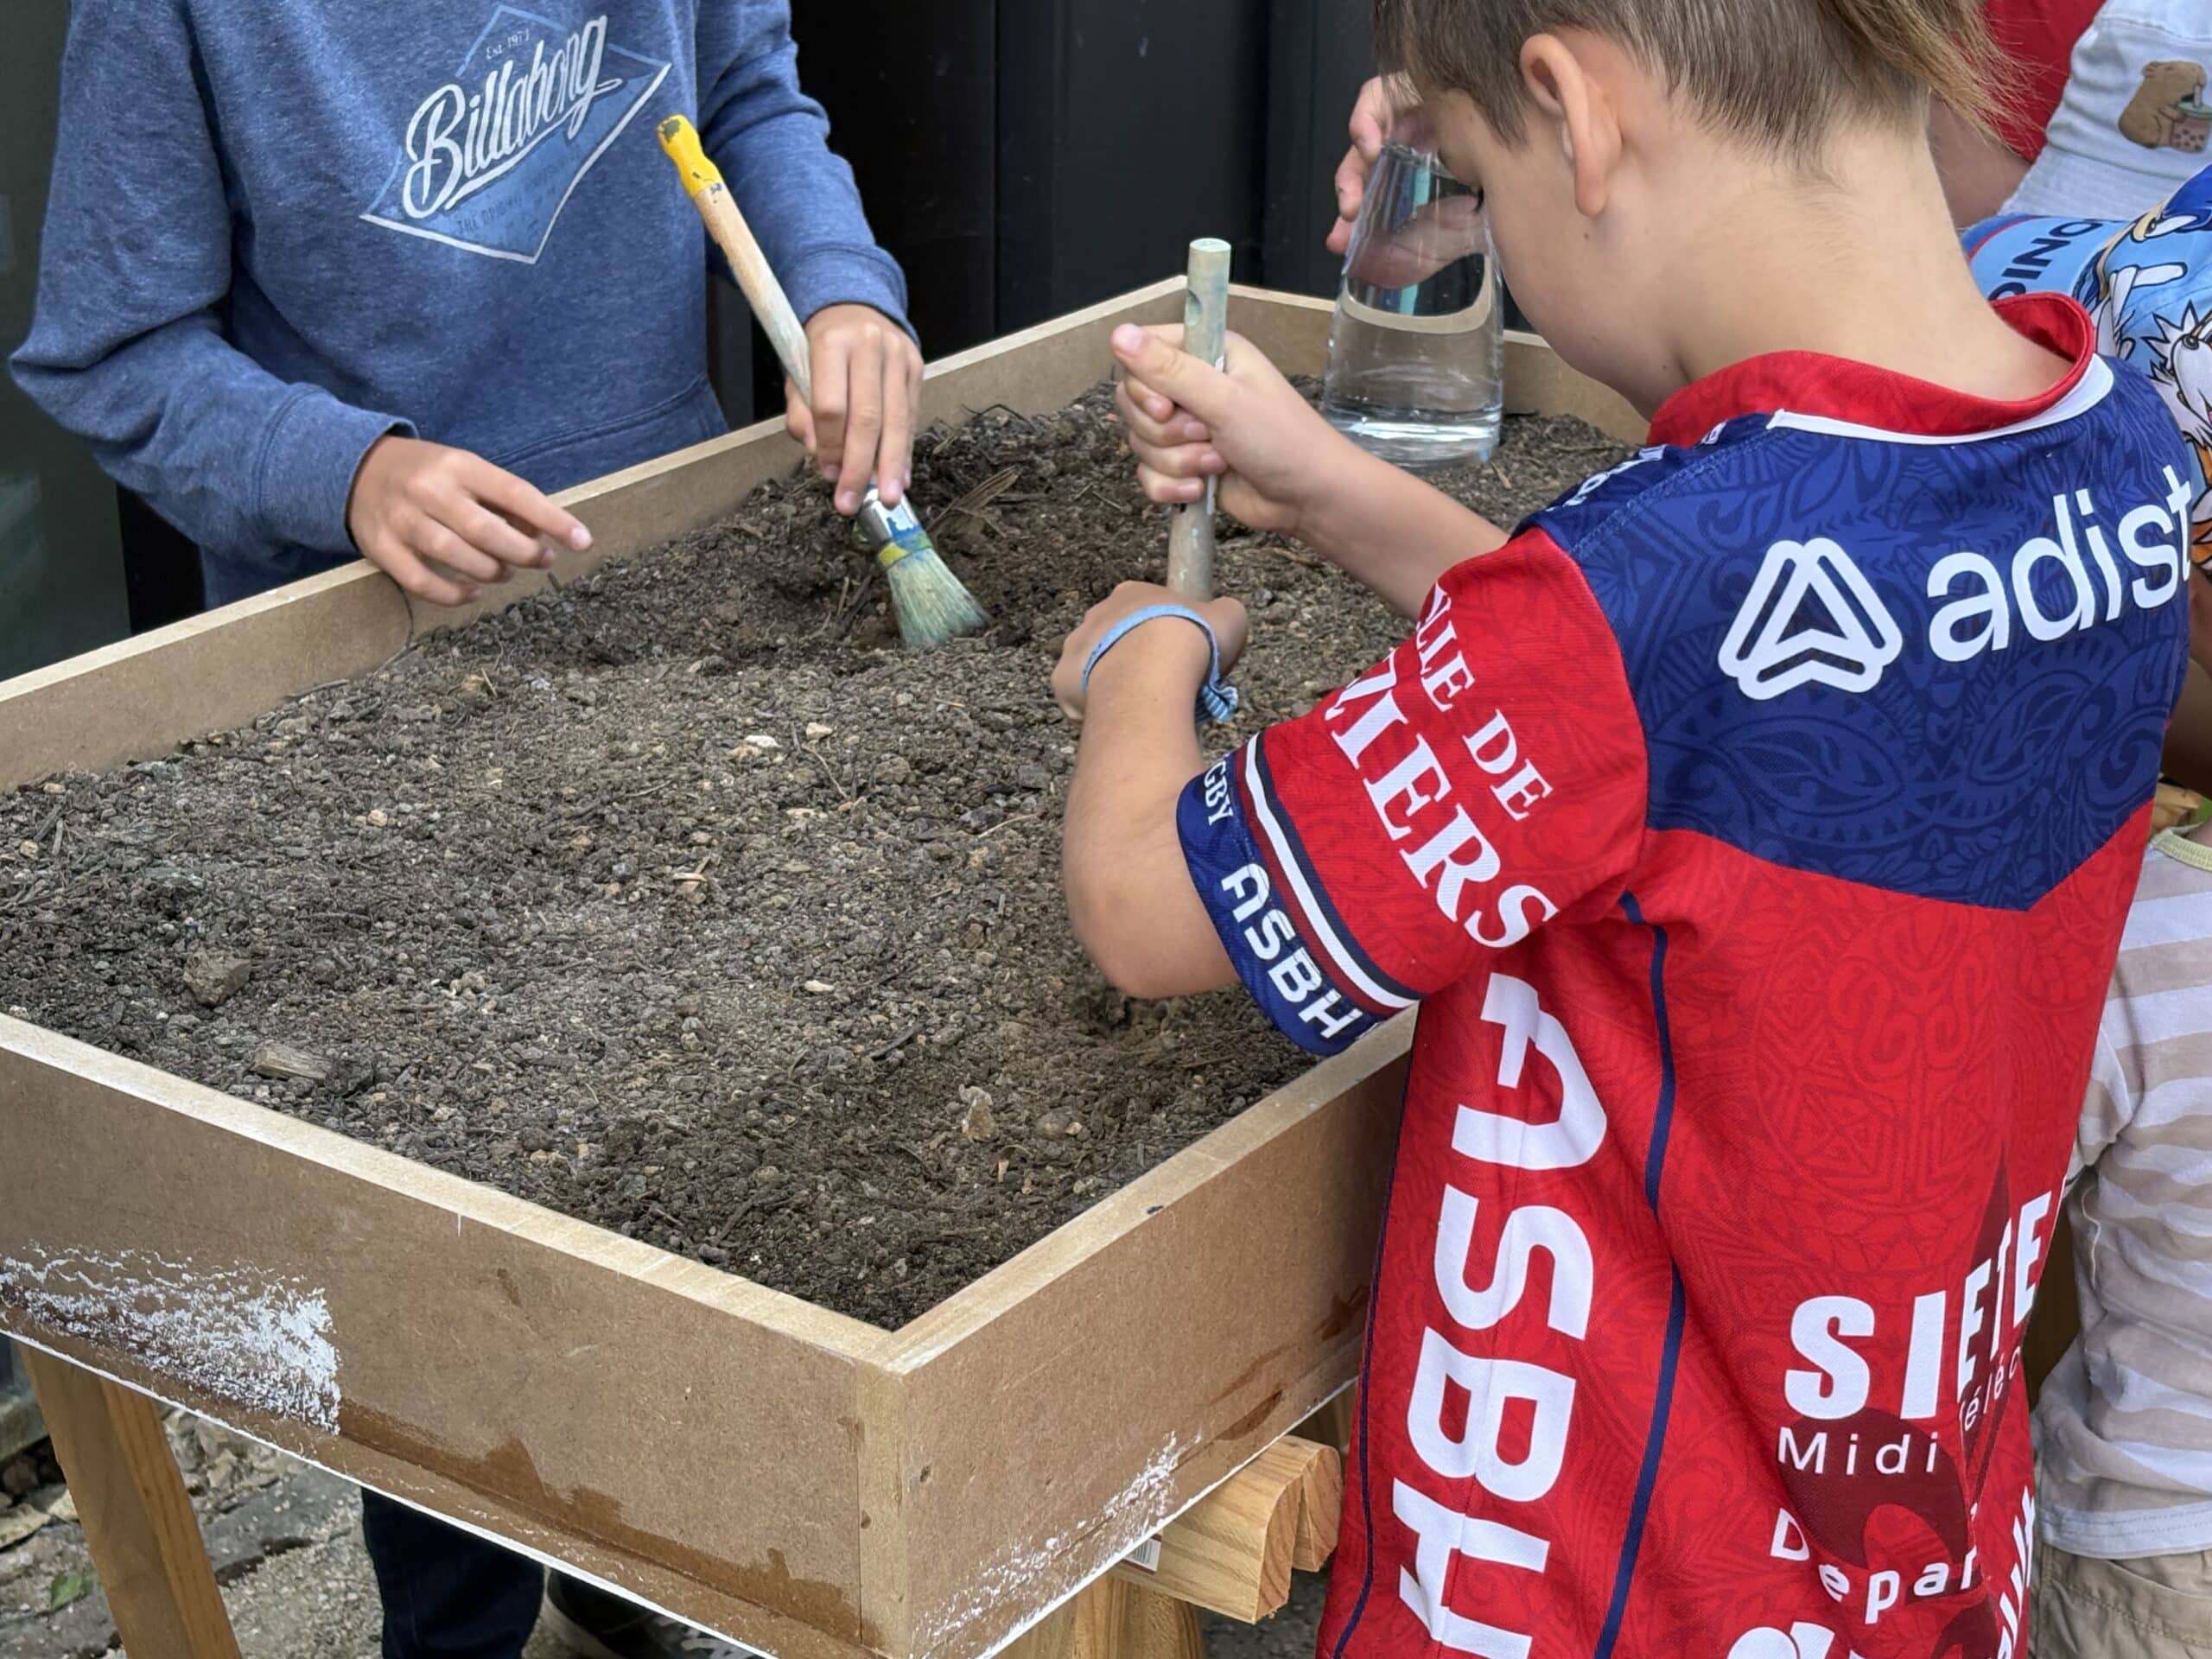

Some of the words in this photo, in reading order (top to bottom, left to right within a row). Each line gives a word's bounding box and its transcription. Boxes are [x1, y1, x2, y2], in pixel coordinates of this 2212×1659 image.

[403, 16, 623, 219] Billabong
[1205, 753, 1234, 826] GBY
[1324, 648, 1559, 949] ZIERS
[1463, 709, 1553, 821] DE
[1221, 862, 1364, 1039] ASBH
[1391, 972, 1607, 1659] ASBH
[1777, 1427, 1939, 1476] Midi
[1770, 1506, 1979, 1625] Depar
